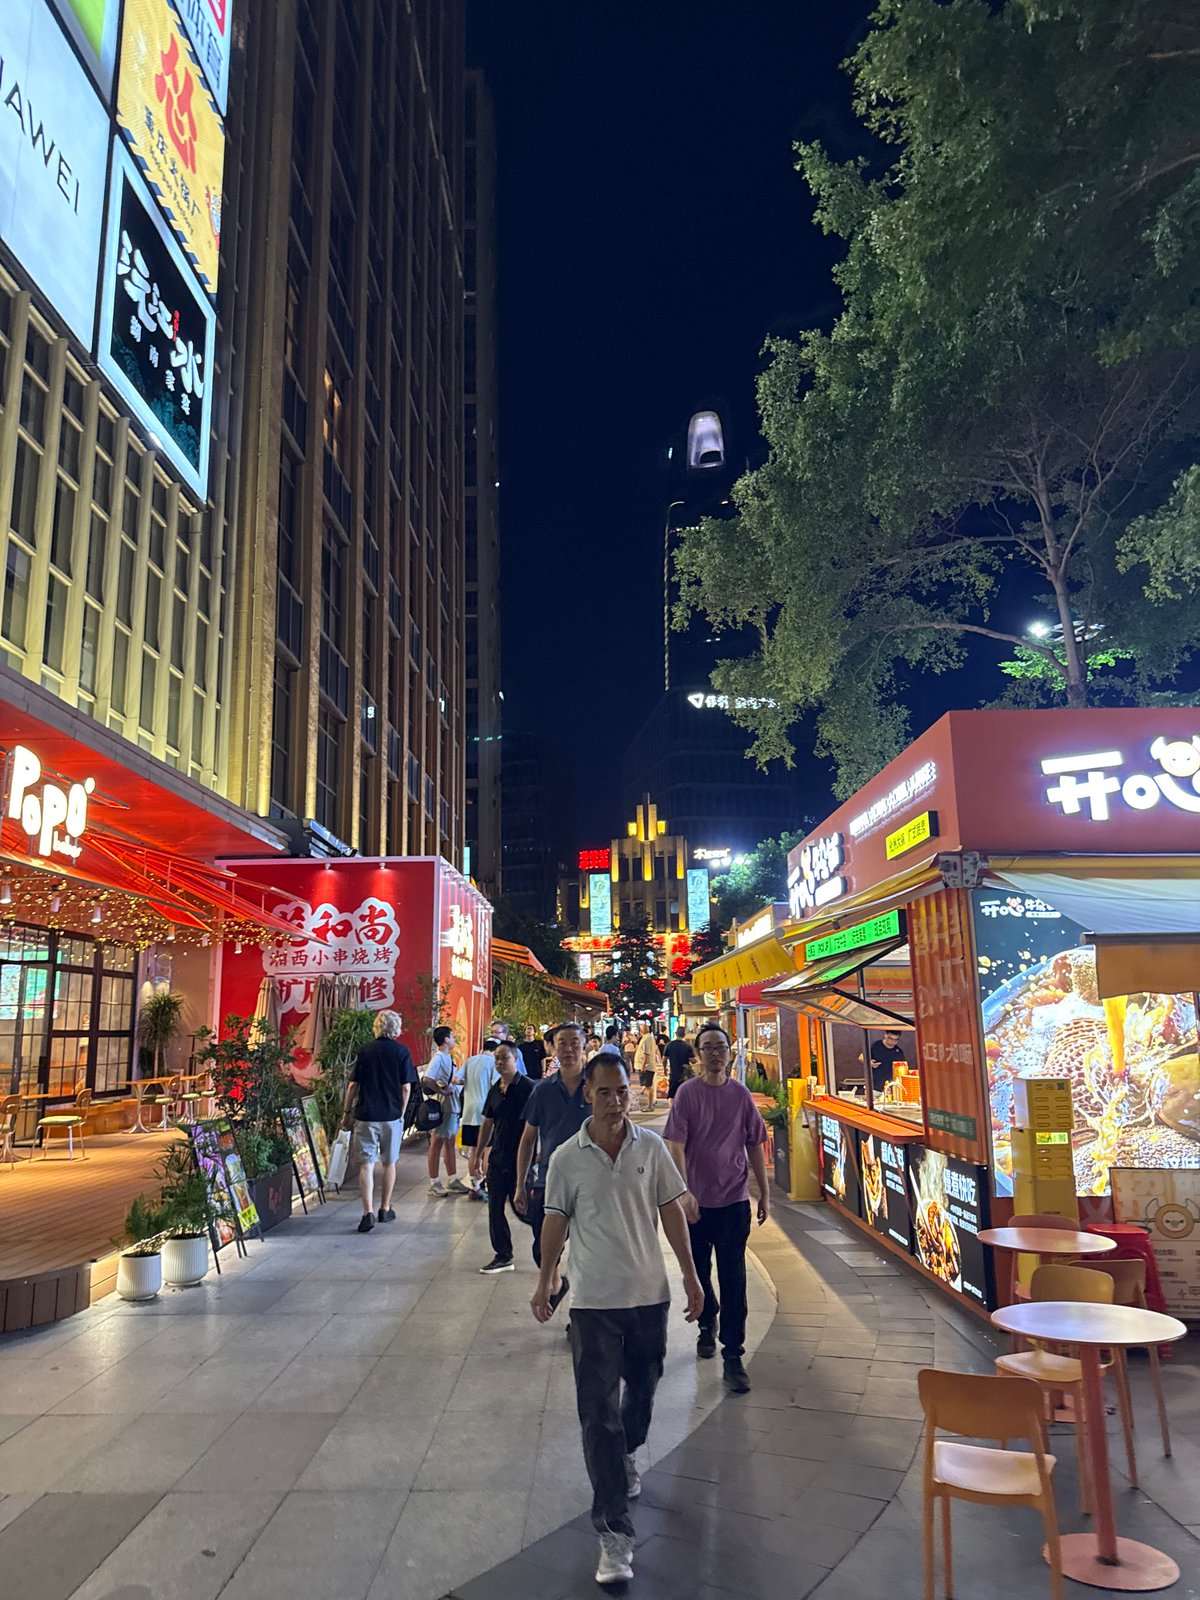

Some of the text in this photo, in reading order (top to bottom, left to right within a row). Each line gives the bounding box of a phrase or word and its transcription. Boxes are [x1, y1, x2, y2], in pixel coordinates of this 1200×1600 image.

[0, 57, 80, 216] AWEI
[269, 946, 393, 967] 湘西小串烧烤
